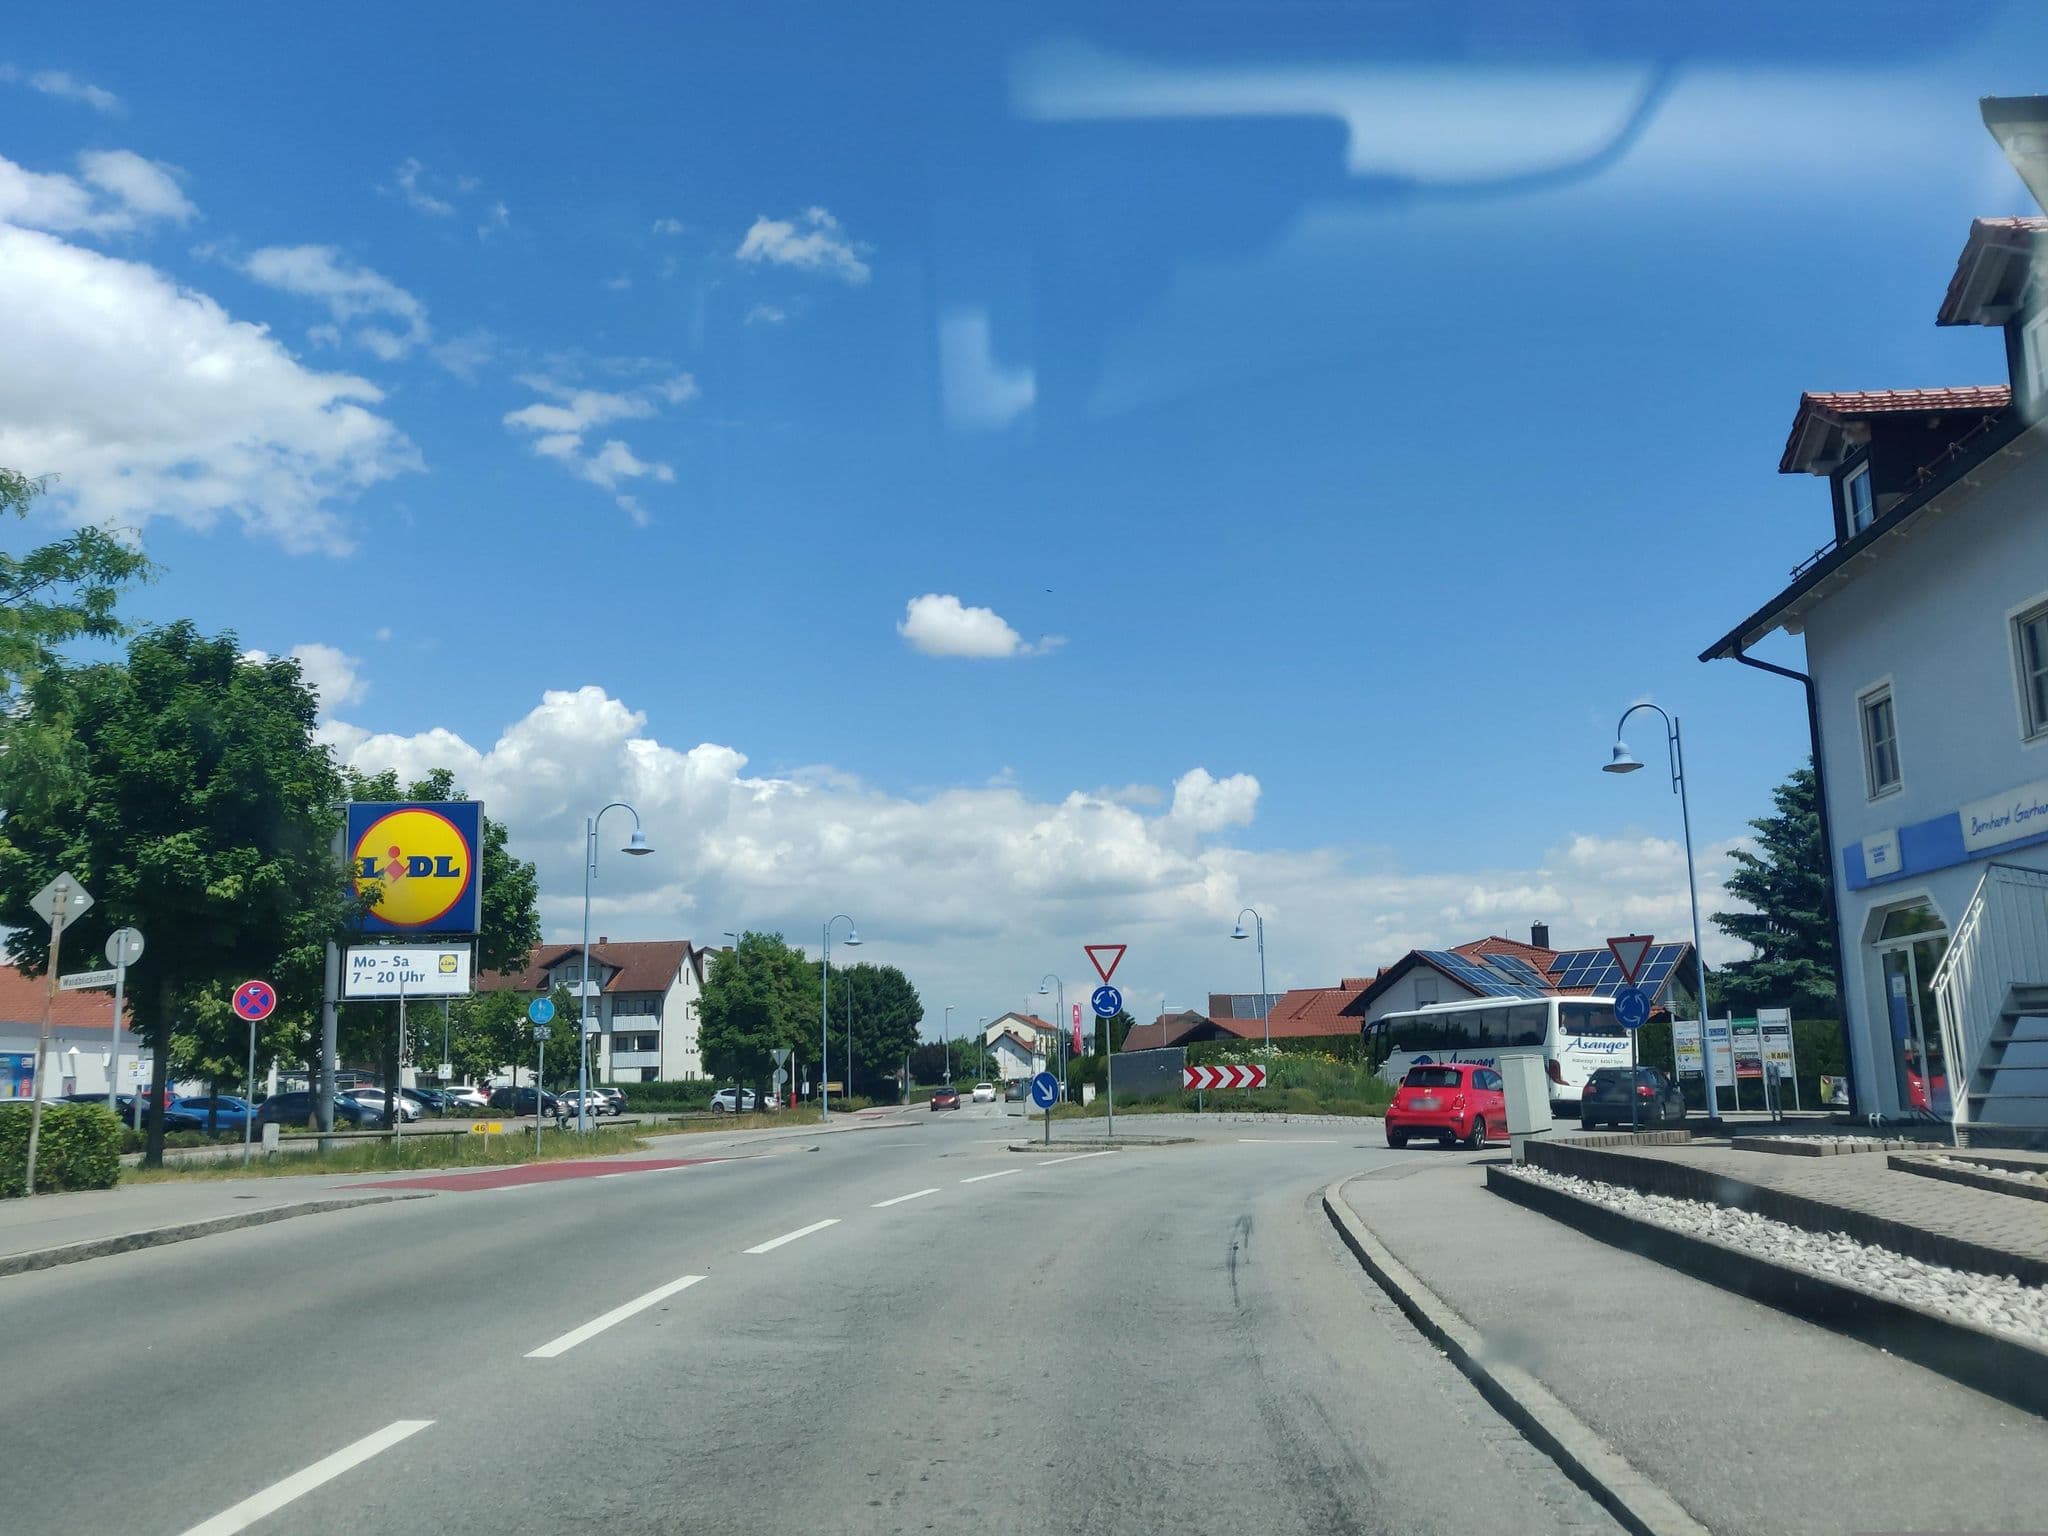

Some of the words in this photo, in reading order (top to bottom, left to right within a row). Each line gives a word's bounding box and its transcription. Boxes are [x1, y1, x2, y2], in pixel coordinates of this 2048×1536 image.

[354, 956, 377, 968] Mo
[393, 955, 410, 967] Sa
[353, 972, 361, 984] 7
[377, 971, 395, 983] 20
[400, 971, 425, 982] Uhr
[1565, 1037, 1629, 1053] Asanger
[474, 1124, 486, 1132] 46
